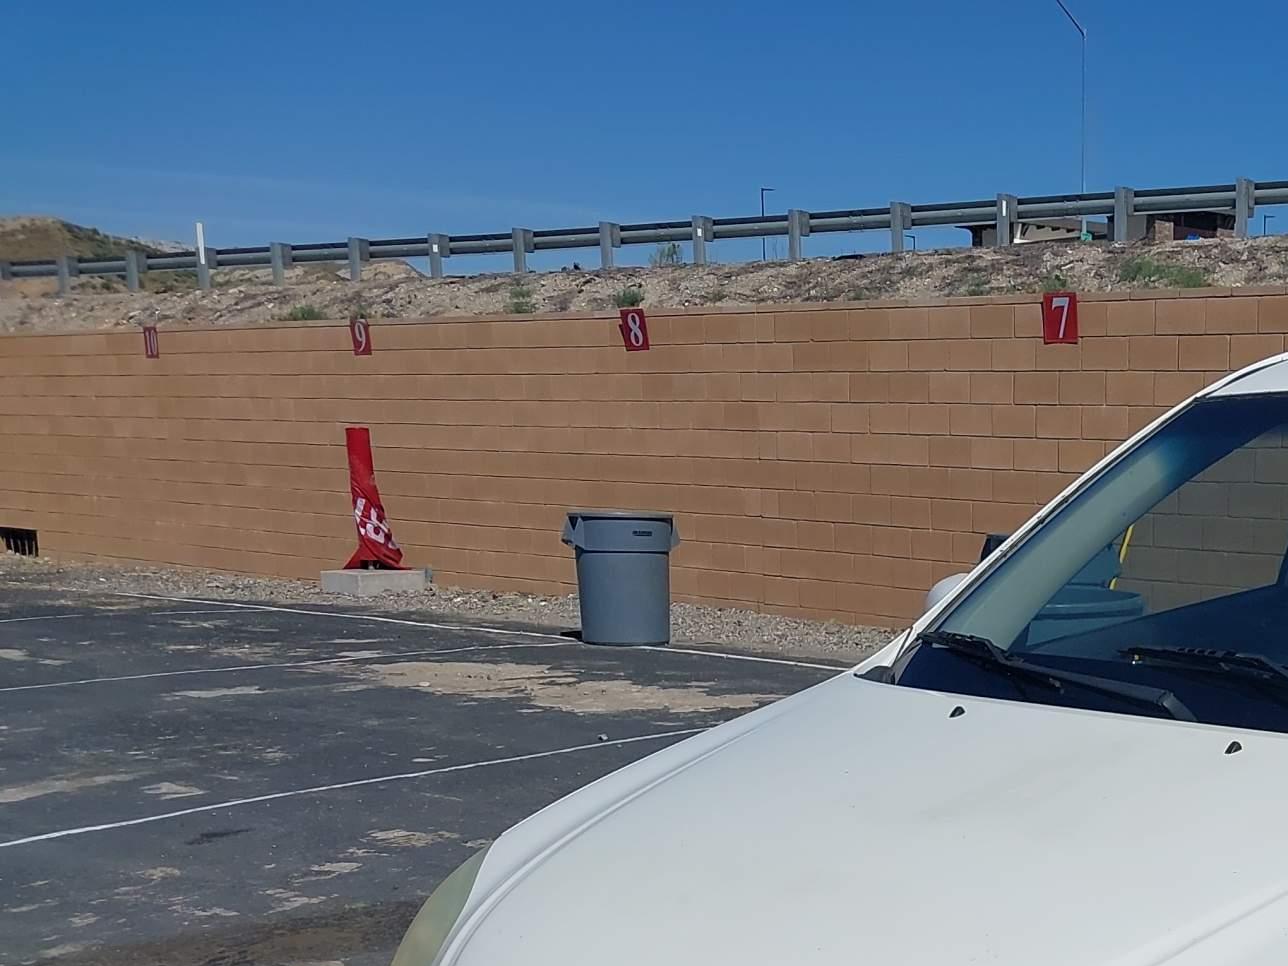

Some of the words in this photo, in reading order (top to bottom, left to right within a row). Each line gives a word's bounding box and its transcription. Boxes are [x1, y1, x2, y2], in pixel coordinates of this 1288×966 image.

[627, 312, 644, 347] 8
[1051, 296, 1070, 339] 7
[145, 329, 158, 355] 10
[354, 321, 366, 352] 9
